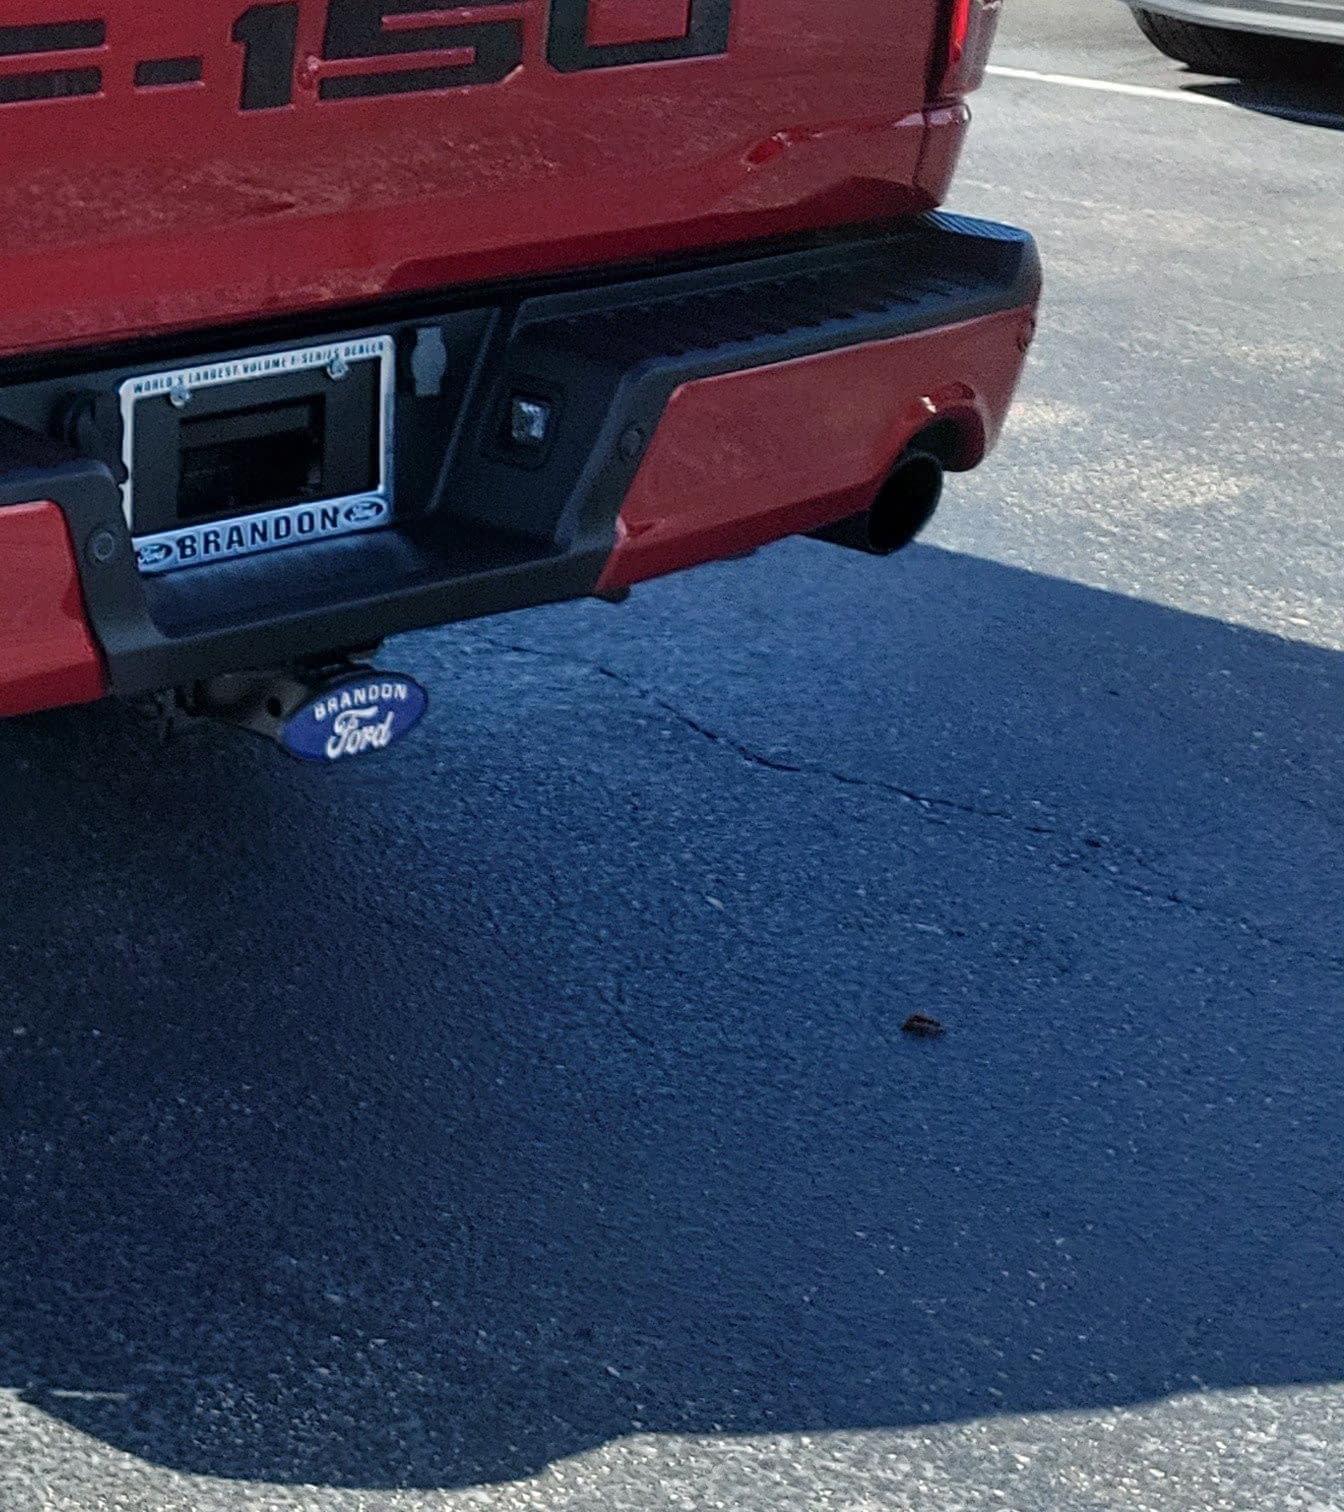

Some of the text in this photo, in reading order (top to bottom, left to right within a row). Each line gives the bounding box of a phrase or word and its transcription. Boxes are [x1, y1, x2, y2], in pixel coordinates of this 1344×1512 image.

[188, 365, 238, 384] LARGEST
[344, 341, 384, 357] DEALER
[176, 506, 340, 560] BRANDON
[314, 683, 407, 721] BRANDON
[326, 705, 395, 759] Ford
